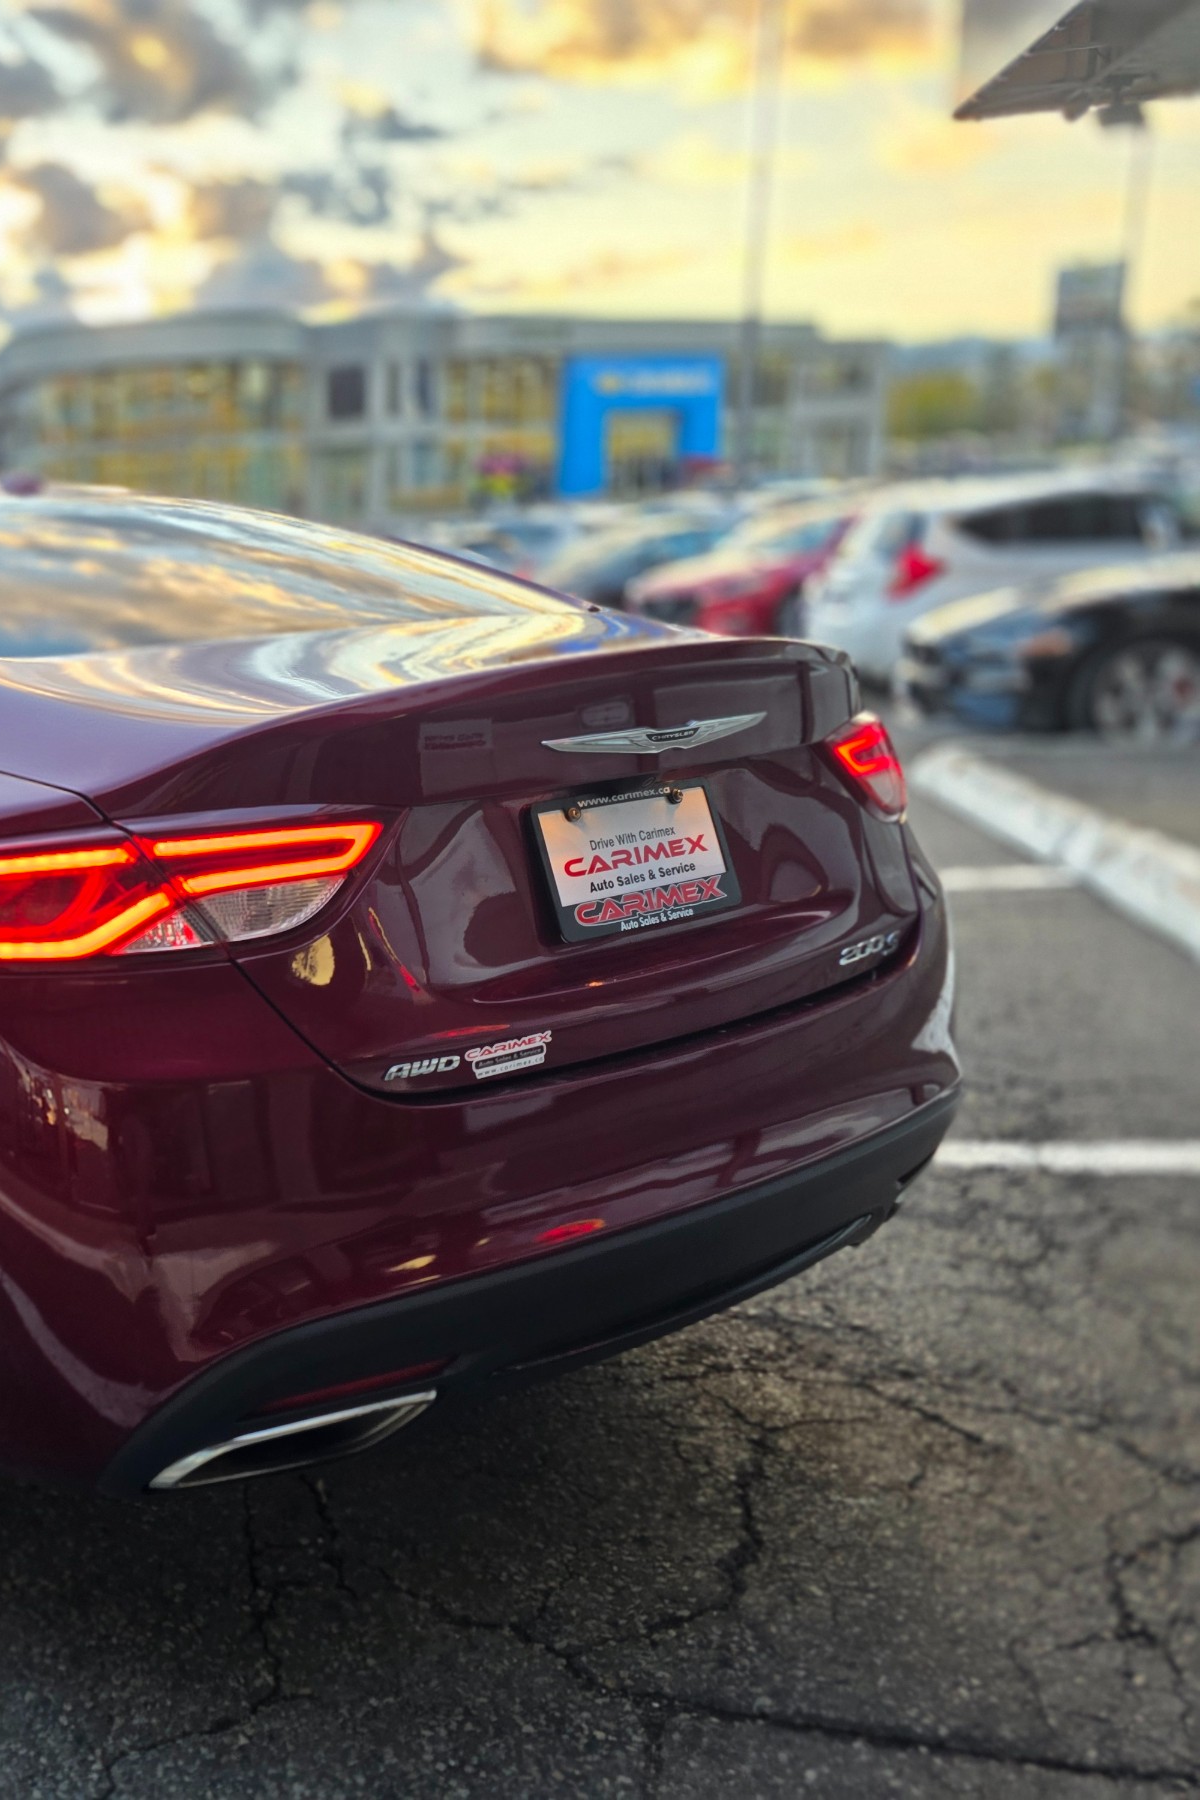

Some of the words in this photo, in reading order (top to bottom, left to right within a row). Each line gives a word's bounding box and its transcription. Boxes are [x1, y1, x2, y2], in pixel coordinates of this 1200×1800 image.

[651, 730, 695, 741] CHRYSLER
[577, 786, 671, 808] www.carimex.ca
[589, 837, 615, 851] Drive
[615, 832, 637, 846] With
[638, 826, 676, 841] Carimex
[564, 834, 709, 877] CARIMEX
[589, 880, 615, 893] Auto
[616, 871, 646, 887] Sales
[648, 869, 656, 880] &
[658, 861, 696, 878] Service
[575, 874, 728, 926] CARIMEX
[620, 919, 639, 932] Auto
[639, 915, 660, 928] Sales
[660, 913, 667, 922] &
[667, 907, 694, 921] Service
[466, 1032, 550, 1059] CARIMEX
[384, 1055, 461, 1081] AWD
